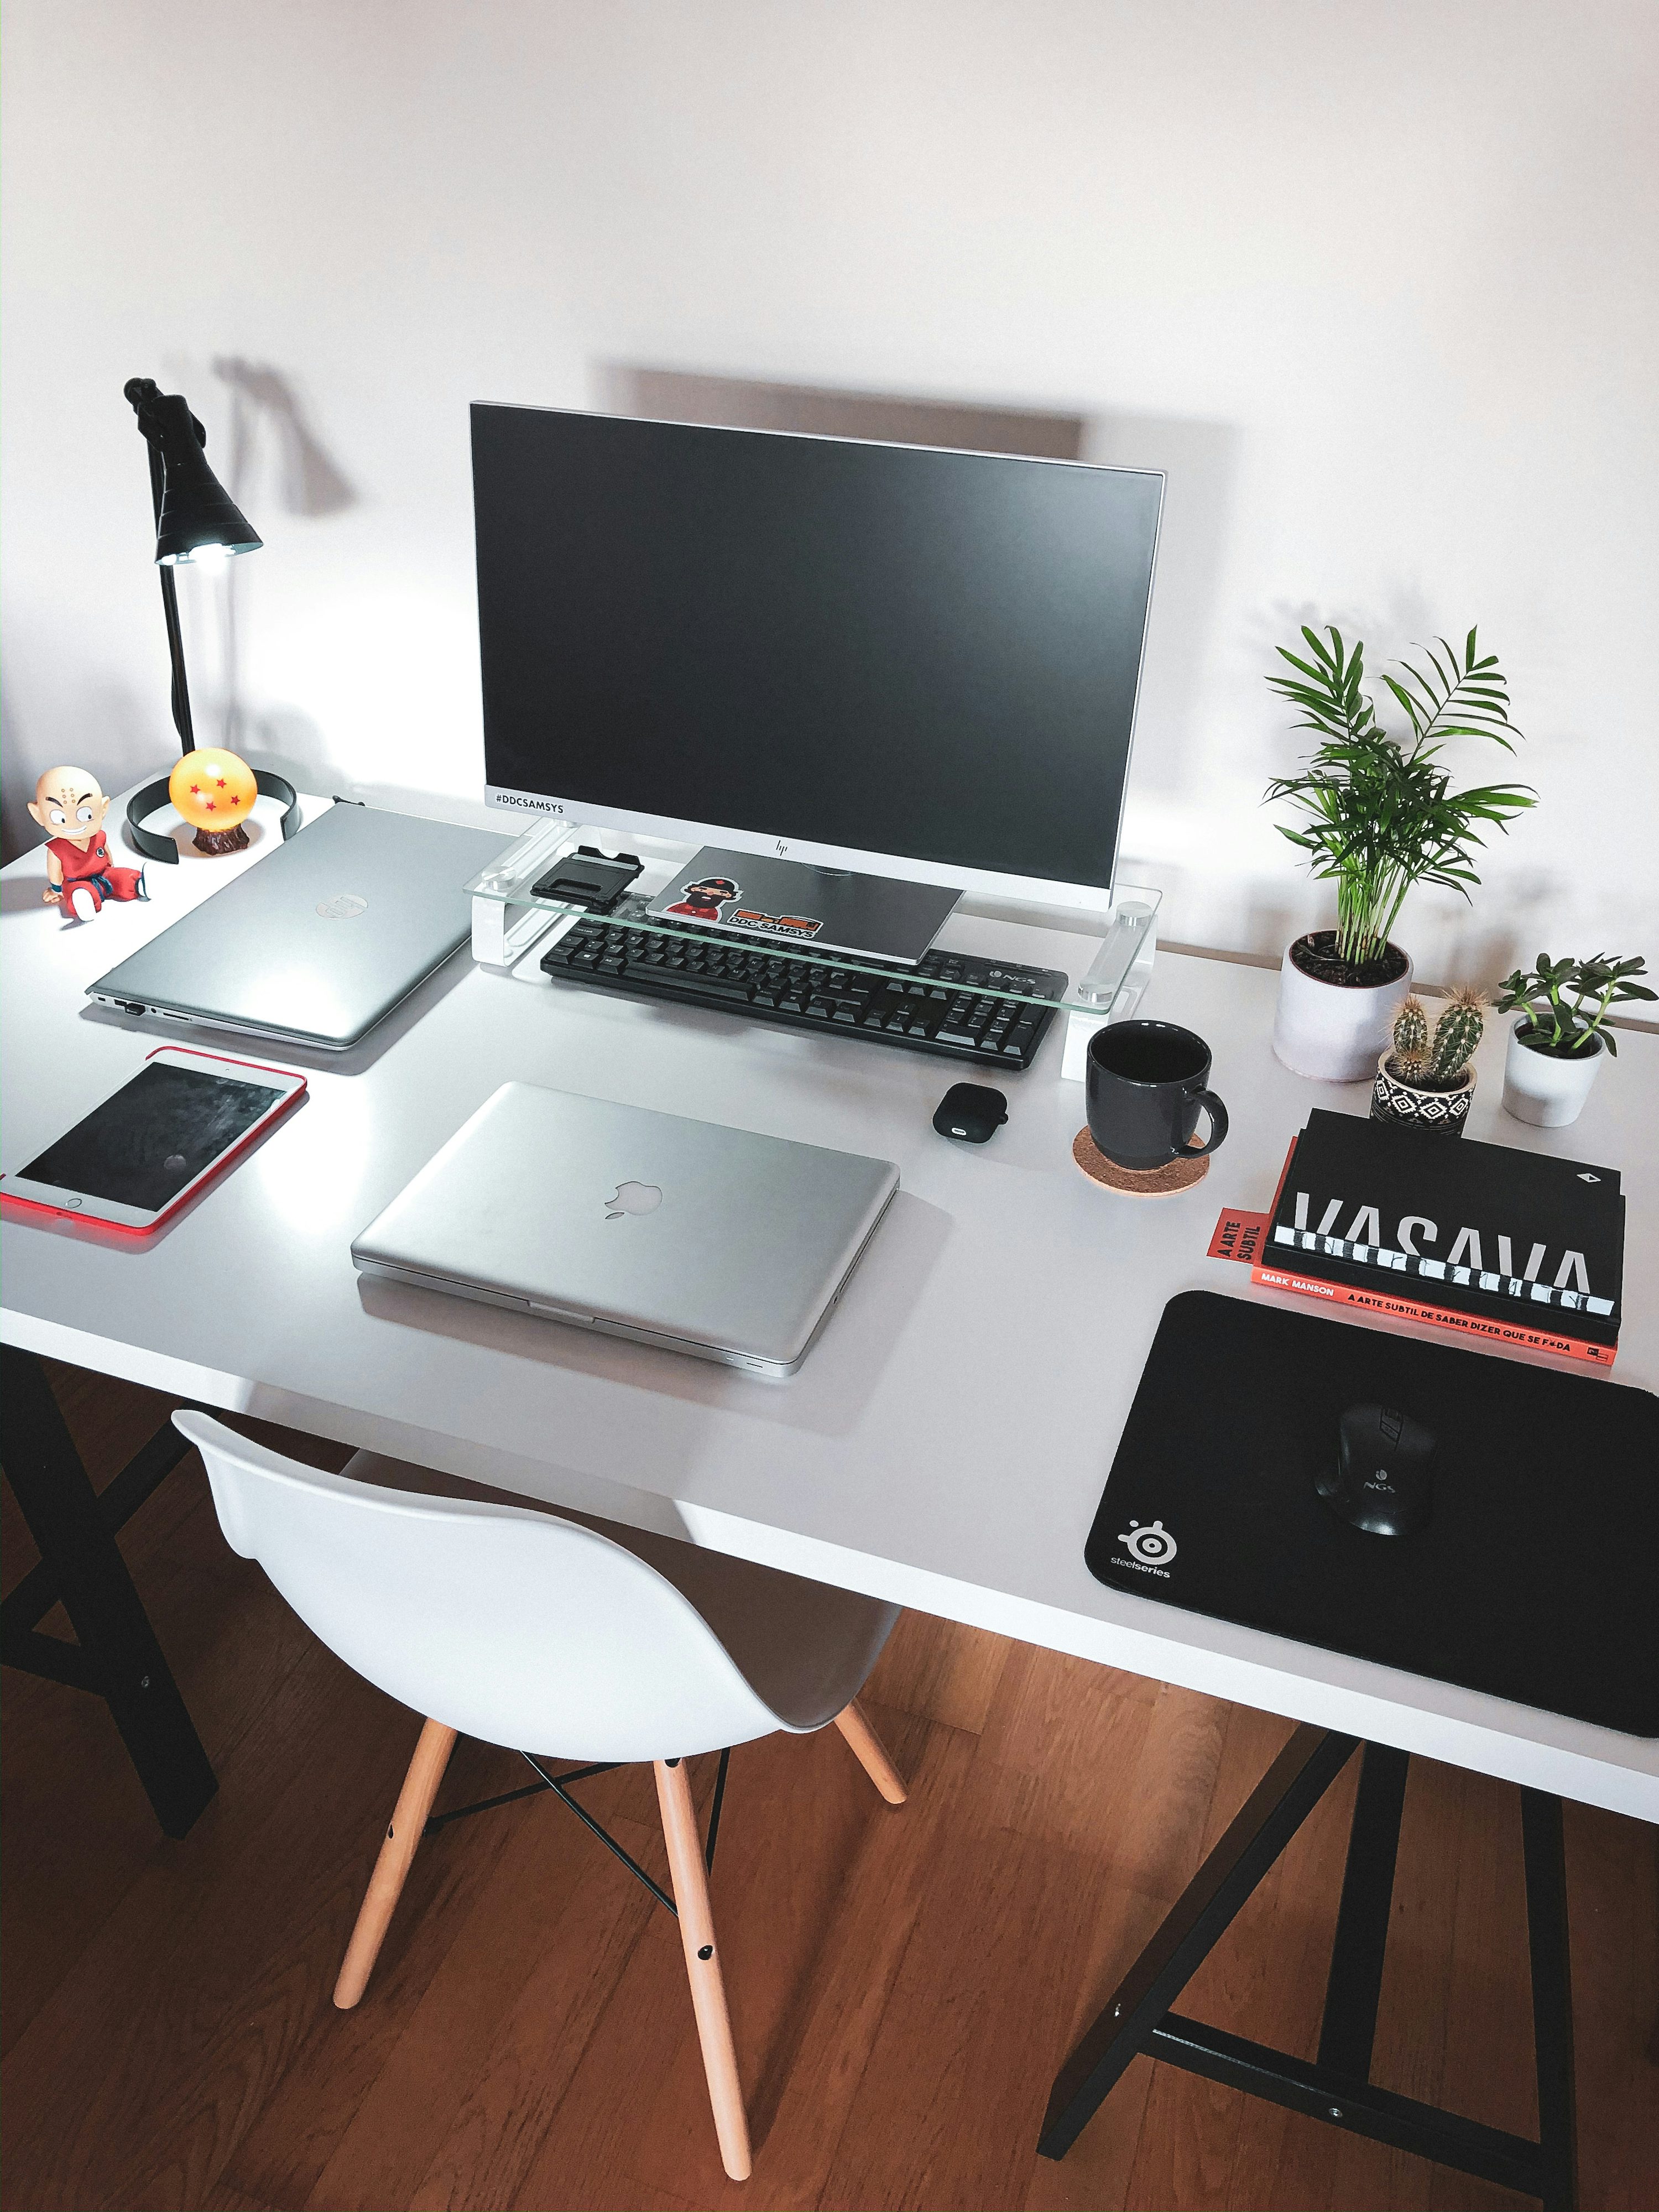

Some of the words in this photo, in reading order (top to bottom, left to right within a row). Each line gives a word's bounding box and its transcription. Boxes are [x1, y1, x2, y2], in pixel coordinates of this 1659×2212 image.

[496, 794, 564, 814] #DDCSAMSYS
[729, 917, 758, 927] DDC
[759, 922, 813, 938] SAMSYS
[1003, 974, 1036, 984] NGS
[1219, 1220, 1241, 1248] ARTE
[1236, 1225, 1261, 1261] SUBTIL
[1217, 1249, 1233, 1258] A
[1261, 1272, 1289, 1286] MARK
[1292, 1280, 1334, 1297] MANSON
[1357, 1296, 1384, 1308] ARTE
[1385, 1302, 1419, 1316] SUBTIL
[1420, 1310, 1433, 1319] DE
[1435, 1314, 1469, 1328] SABER
[1470, 1322, 1501, 1335] DIZER
[1503, 1329, 1526, 1340] QUE
[1527, 1334, 1541, 1344] SE
[1542, 1338, 1571, 1352] FDA
[1363, 1481, 1396, 1494] NGS
[1110, 1557, 1171, 1578] steelseries
